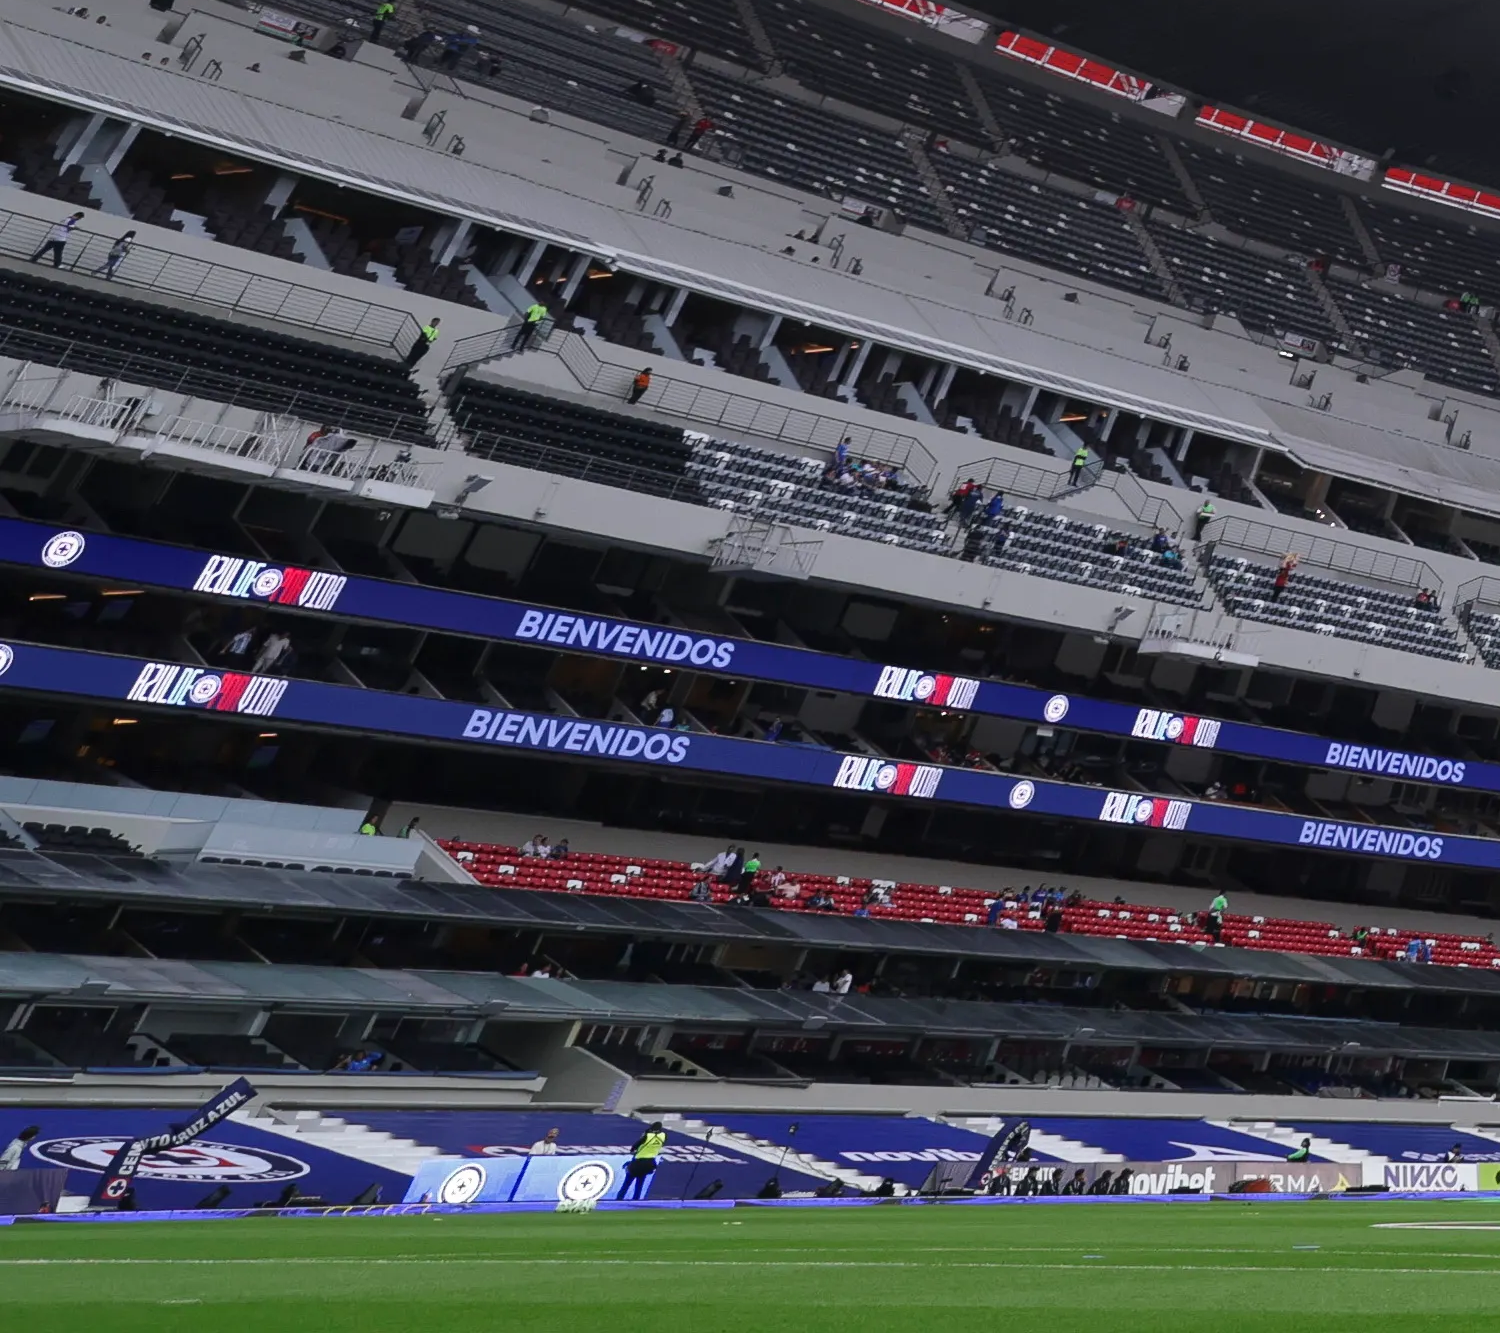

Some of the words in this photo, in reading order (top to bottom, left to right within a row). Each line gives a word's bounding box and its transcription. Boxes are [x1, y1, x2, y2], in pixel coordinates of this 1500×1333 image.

[515, 609, 735, 668] BIENVENIDOS
[462, 709, 691, 763] BIENVENIDOS
[1325, 742, 1466, 783] BIENVENIDOS
[1298, 821, 1444, 859] BIENVENIDOS
[206, 1091, 247, 1124] AZUL
